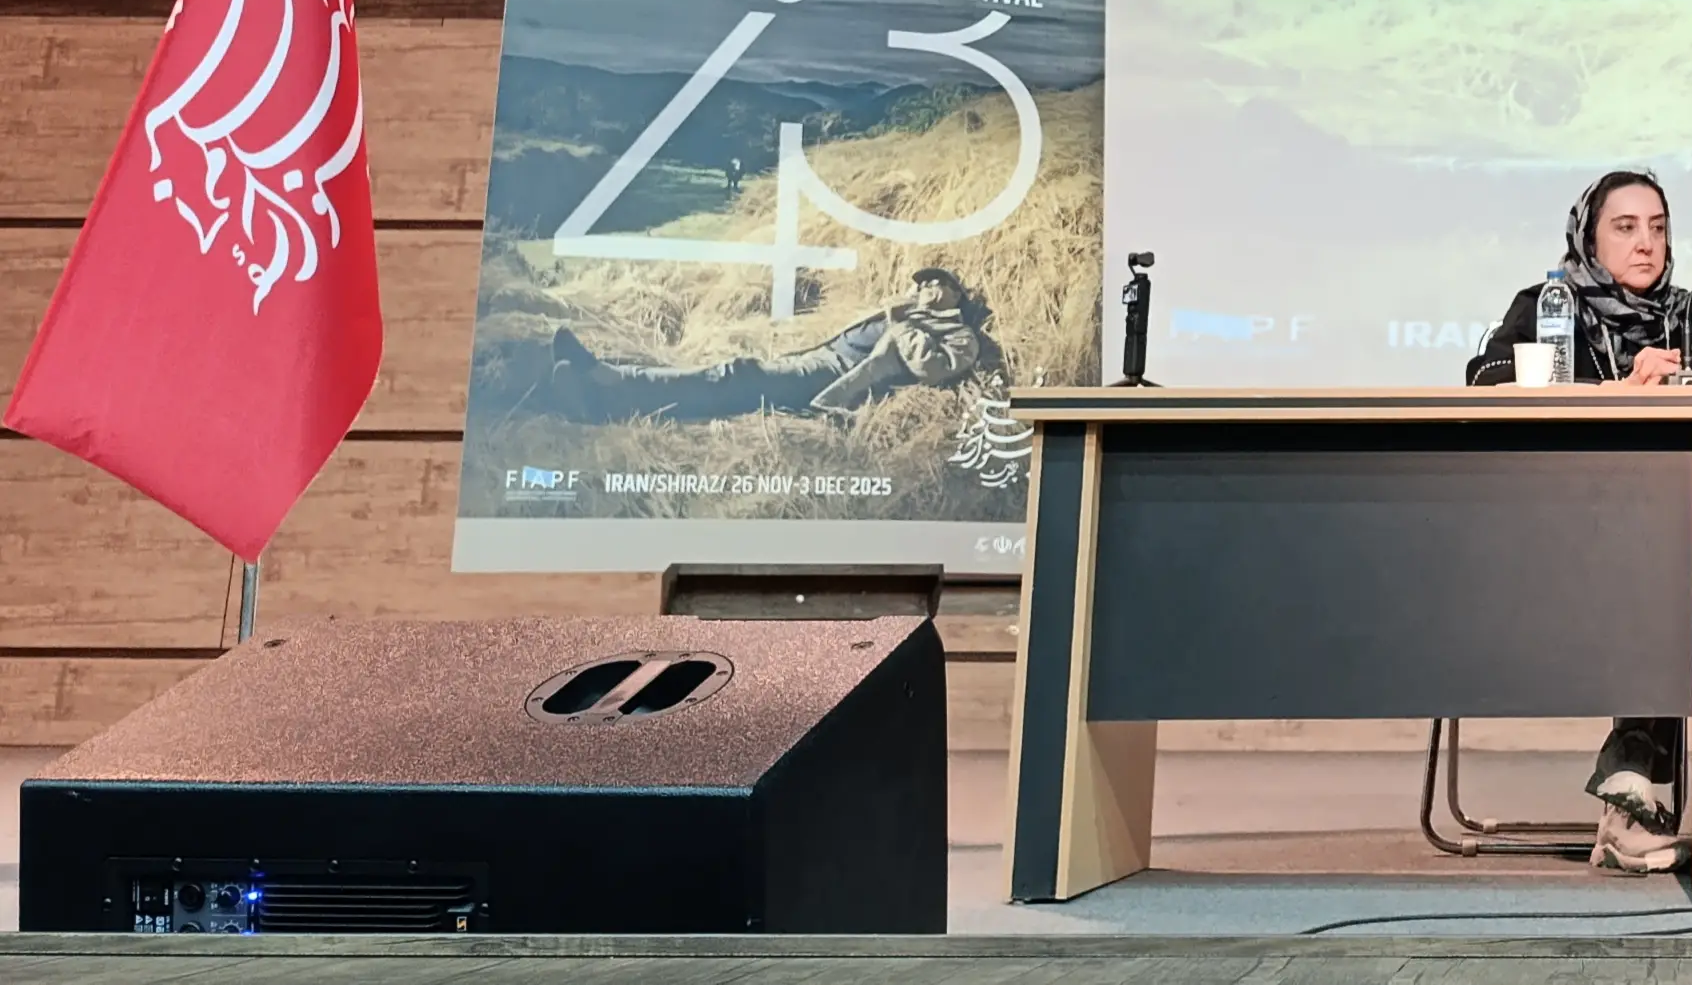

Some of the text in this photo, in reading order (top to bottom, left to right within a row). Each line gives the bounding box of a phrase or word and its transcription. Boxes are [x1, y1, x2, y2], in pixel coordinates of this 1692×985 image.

[505, 469, 580, 489] FIAPF
[731, 475, 753, 493] 26
[815, 476, 846, 495] DEC
[850, 477, 892, 496] 2025
